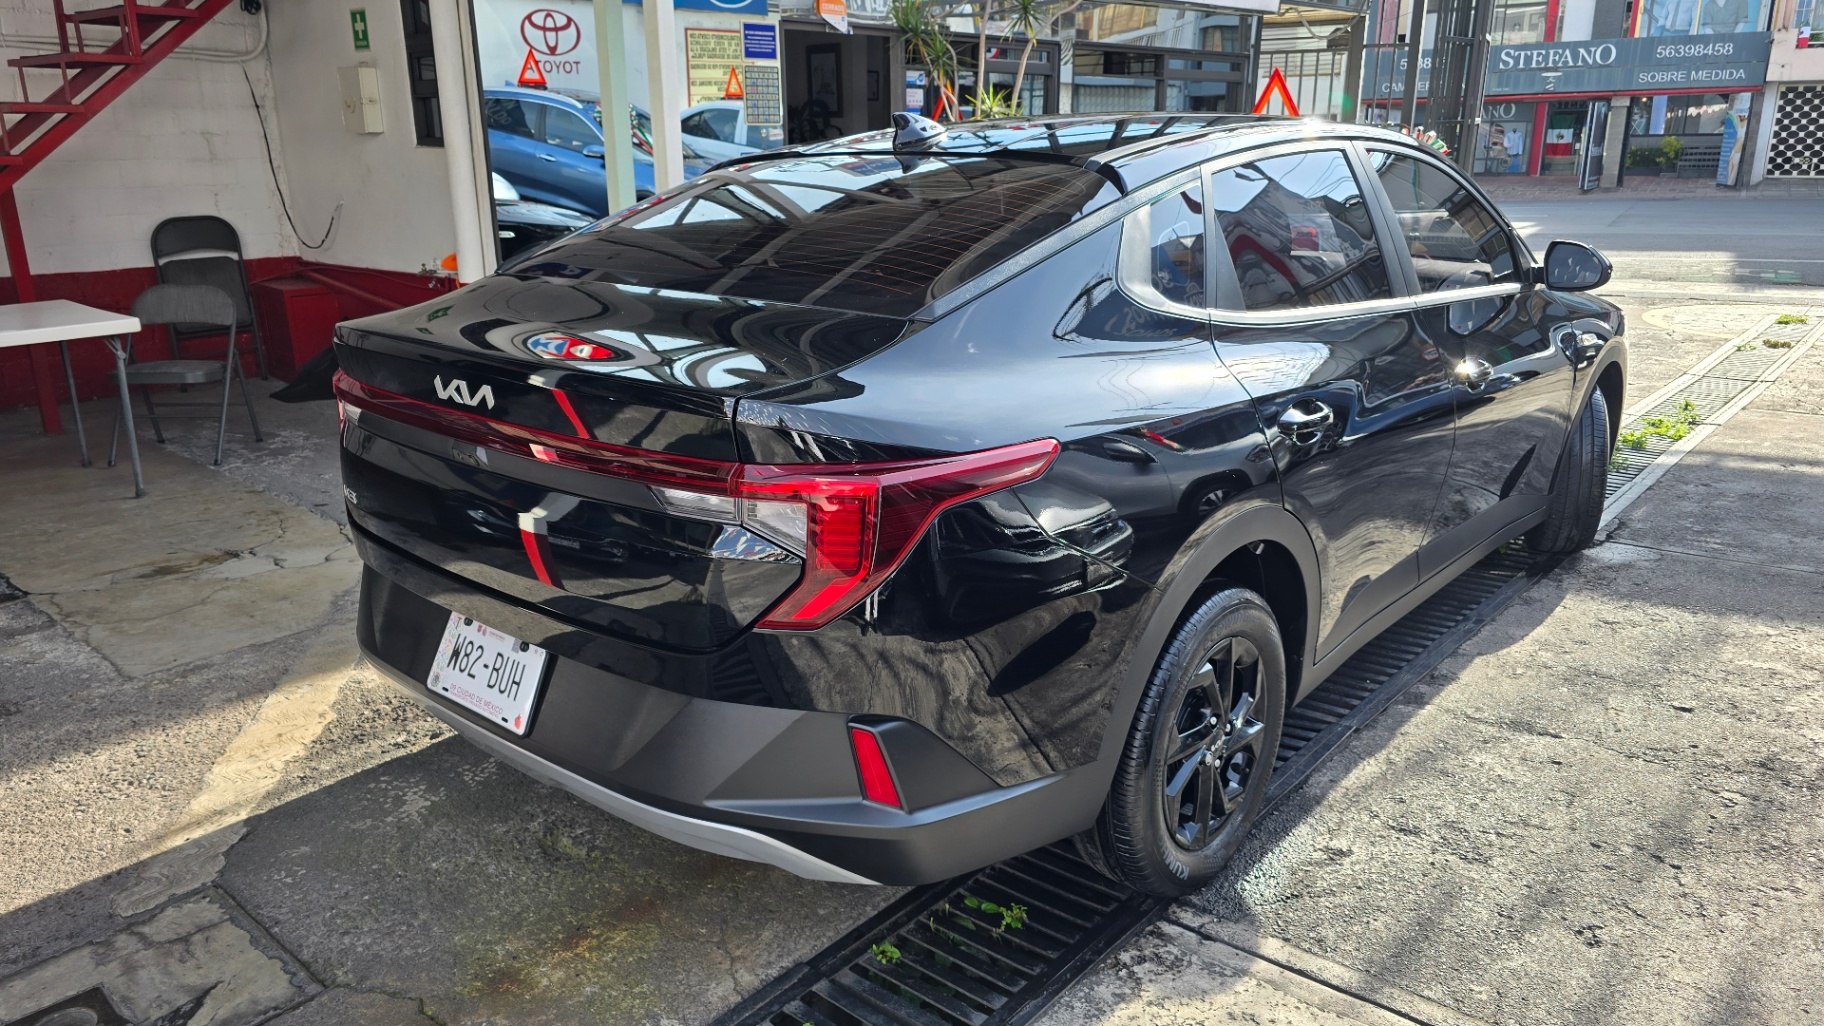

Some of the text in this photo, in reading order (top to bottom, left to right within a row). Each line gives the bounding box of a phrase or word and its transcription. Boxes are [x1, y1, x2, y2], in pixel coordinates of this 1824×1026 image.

[1499, 43, 1617, 69] STEFANO
[1656, 43, 1734, 58] 56398458
[1639, 69, 1746, 83] SOBRE MEDIDA
[434, 375, 494, 410] KIA
[447, 633, 526, 701] W82-BUH
[456, 686, 476, 700] CIUDAD
[476, 696, 483, 705] DE
